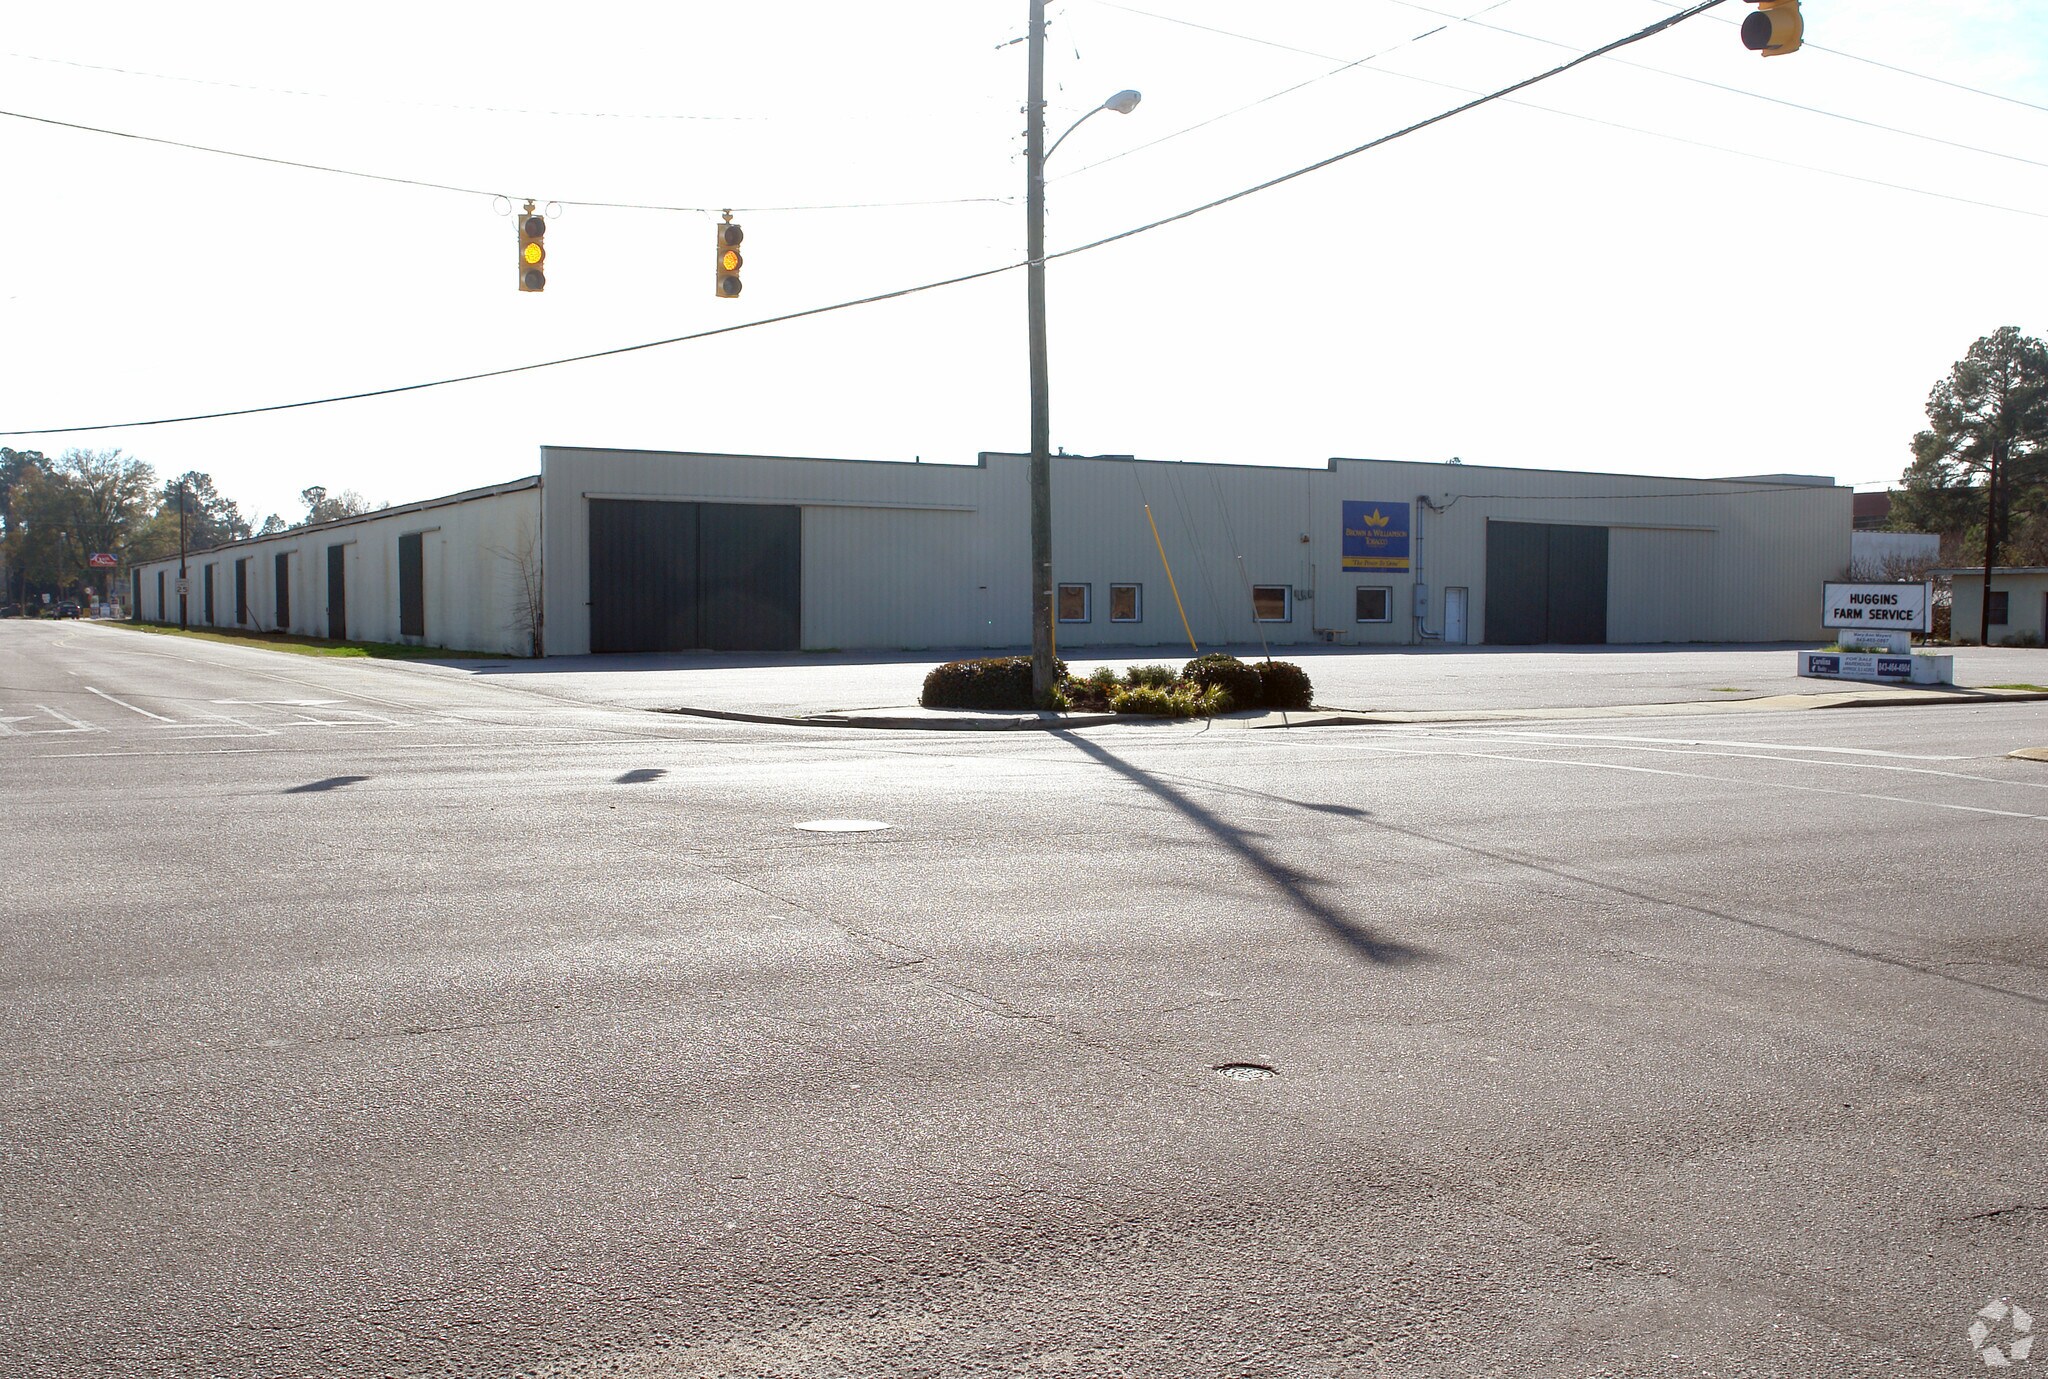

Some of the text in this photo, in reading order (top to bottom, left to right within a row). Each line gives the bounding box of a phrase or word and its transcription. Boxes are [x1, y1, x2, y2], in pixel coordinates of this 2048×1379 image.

[1373, 529, 1408, 538] WILLIAMSON
[1365, 537, 1388, 545] TOBACCO
[1850, 593, 1898, 605] HUGGINS
[1833, 608, 1914, 621] FARM SERVICE
